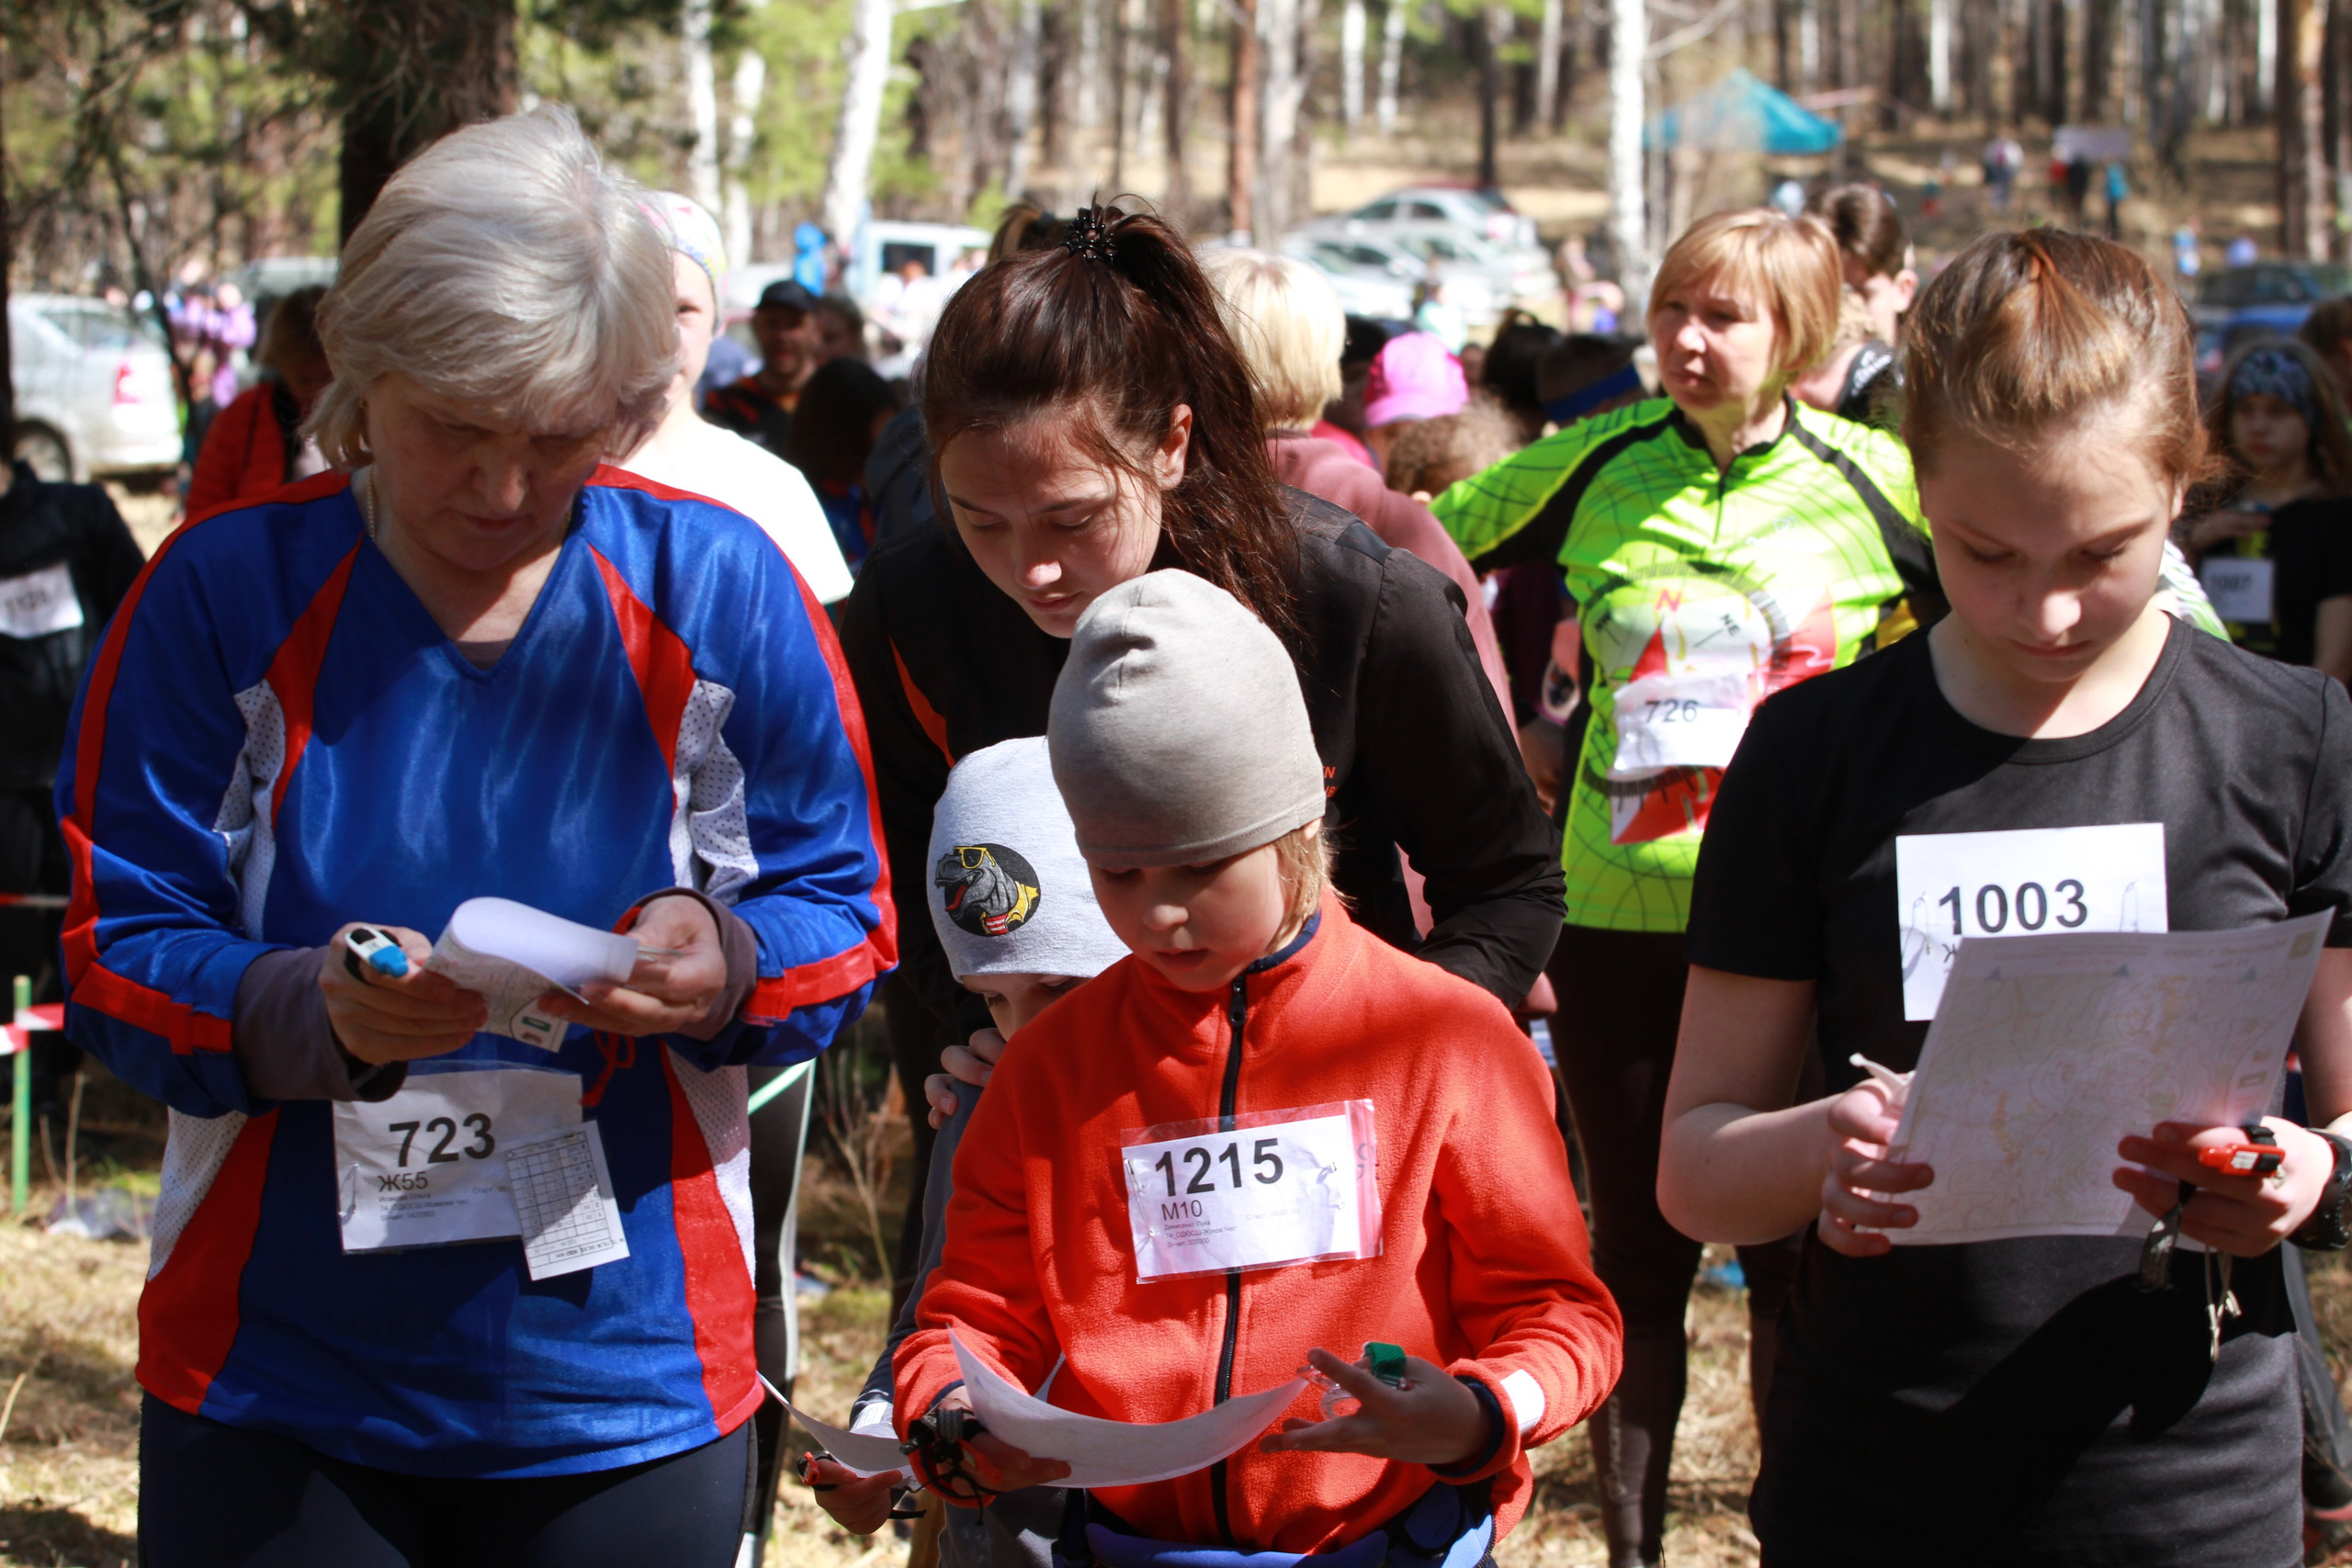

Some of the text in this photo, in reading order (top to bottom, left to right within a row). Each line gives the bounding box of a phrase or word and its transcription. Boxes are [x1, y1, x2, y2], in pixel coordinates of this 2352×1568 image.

[1656, 588, 1683, 613] N
[1720, 613, 1741, 637] NE
[1645, 699, 1699, 723] 726
[1939, 878, 2088, 935] 1003
[389, 1112, 496, 1168] 723
[1155, 1137, 1284, 1197] 1215
[378, 1171, 429, 1192] Ж55
